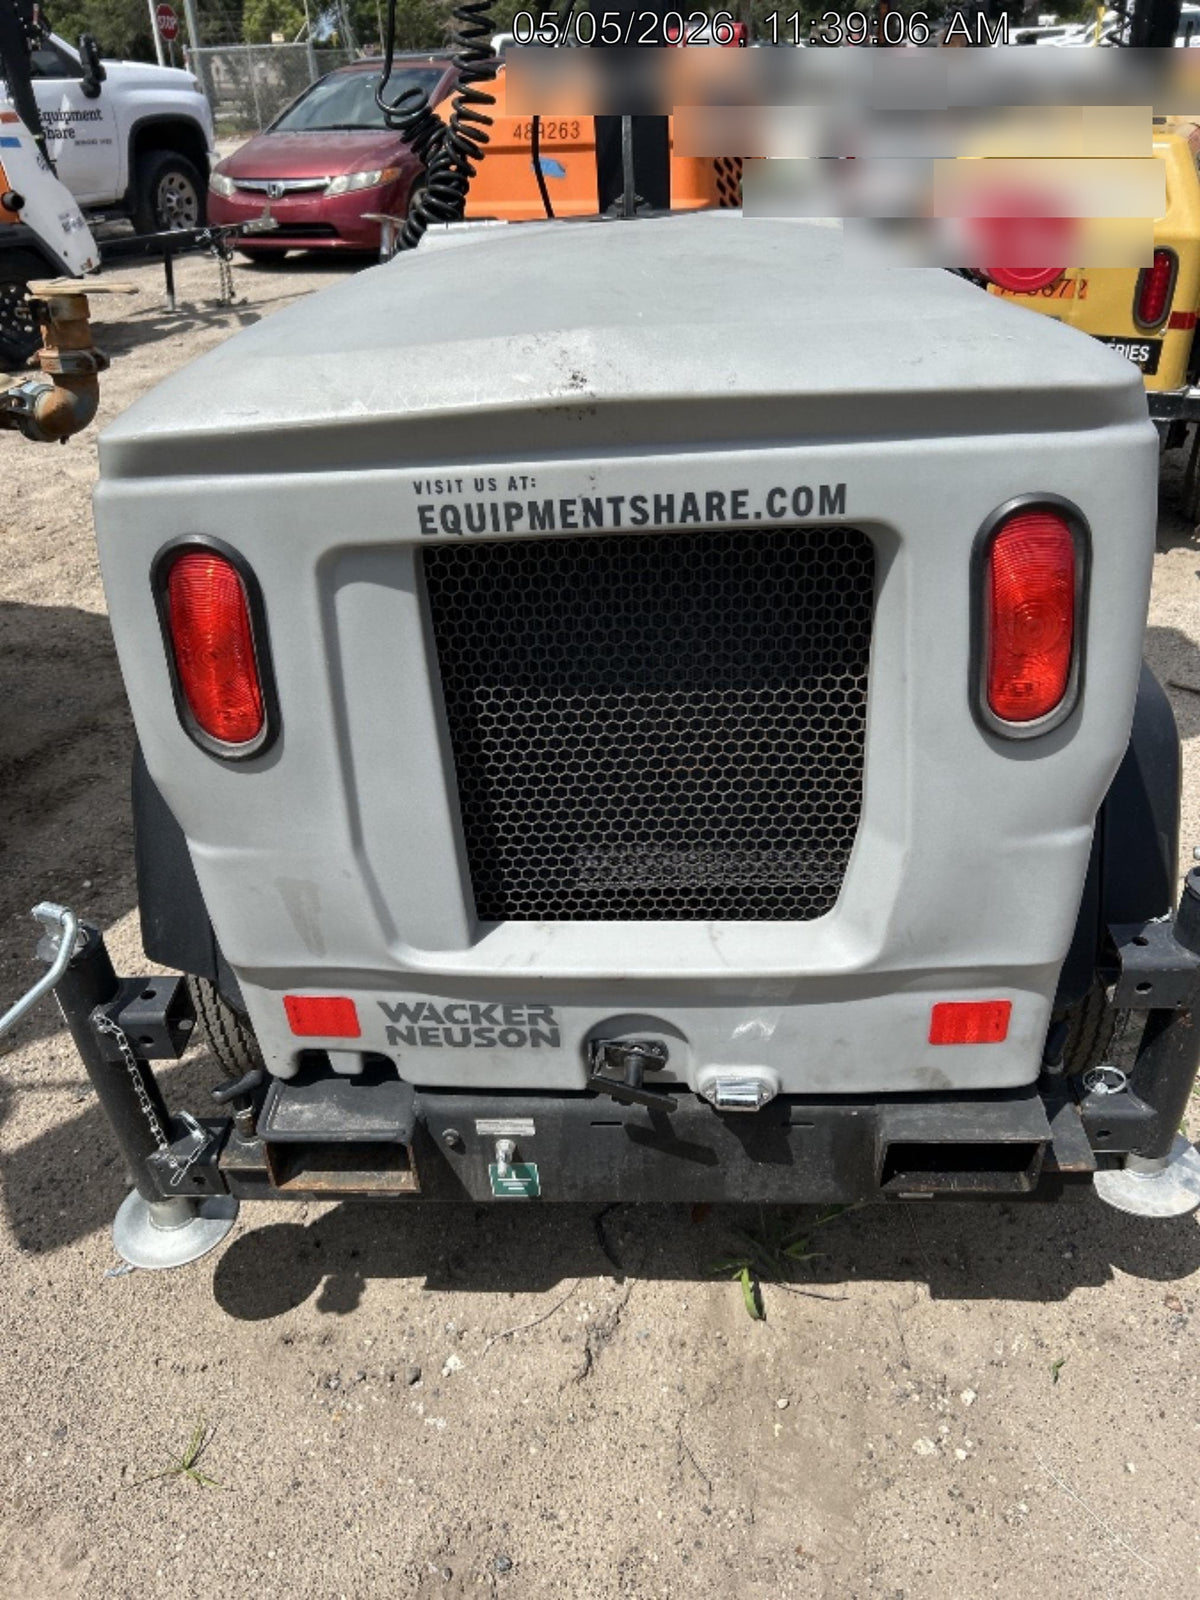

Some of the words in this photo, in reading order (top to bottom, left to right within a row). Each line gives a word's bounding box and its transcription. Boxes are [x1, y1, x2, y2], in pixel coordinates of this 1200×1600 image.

[413, 479, 463, 495] VISIT
[474, 478, 498, 492] US
[507, 476, 537, 491] AT:
[417, 483, 847, 536] EQUIPMENTSHARE.COM
[377, 1002, 559, 1026] WACKER
[385, 1025, 561, 1048] NEUSON
